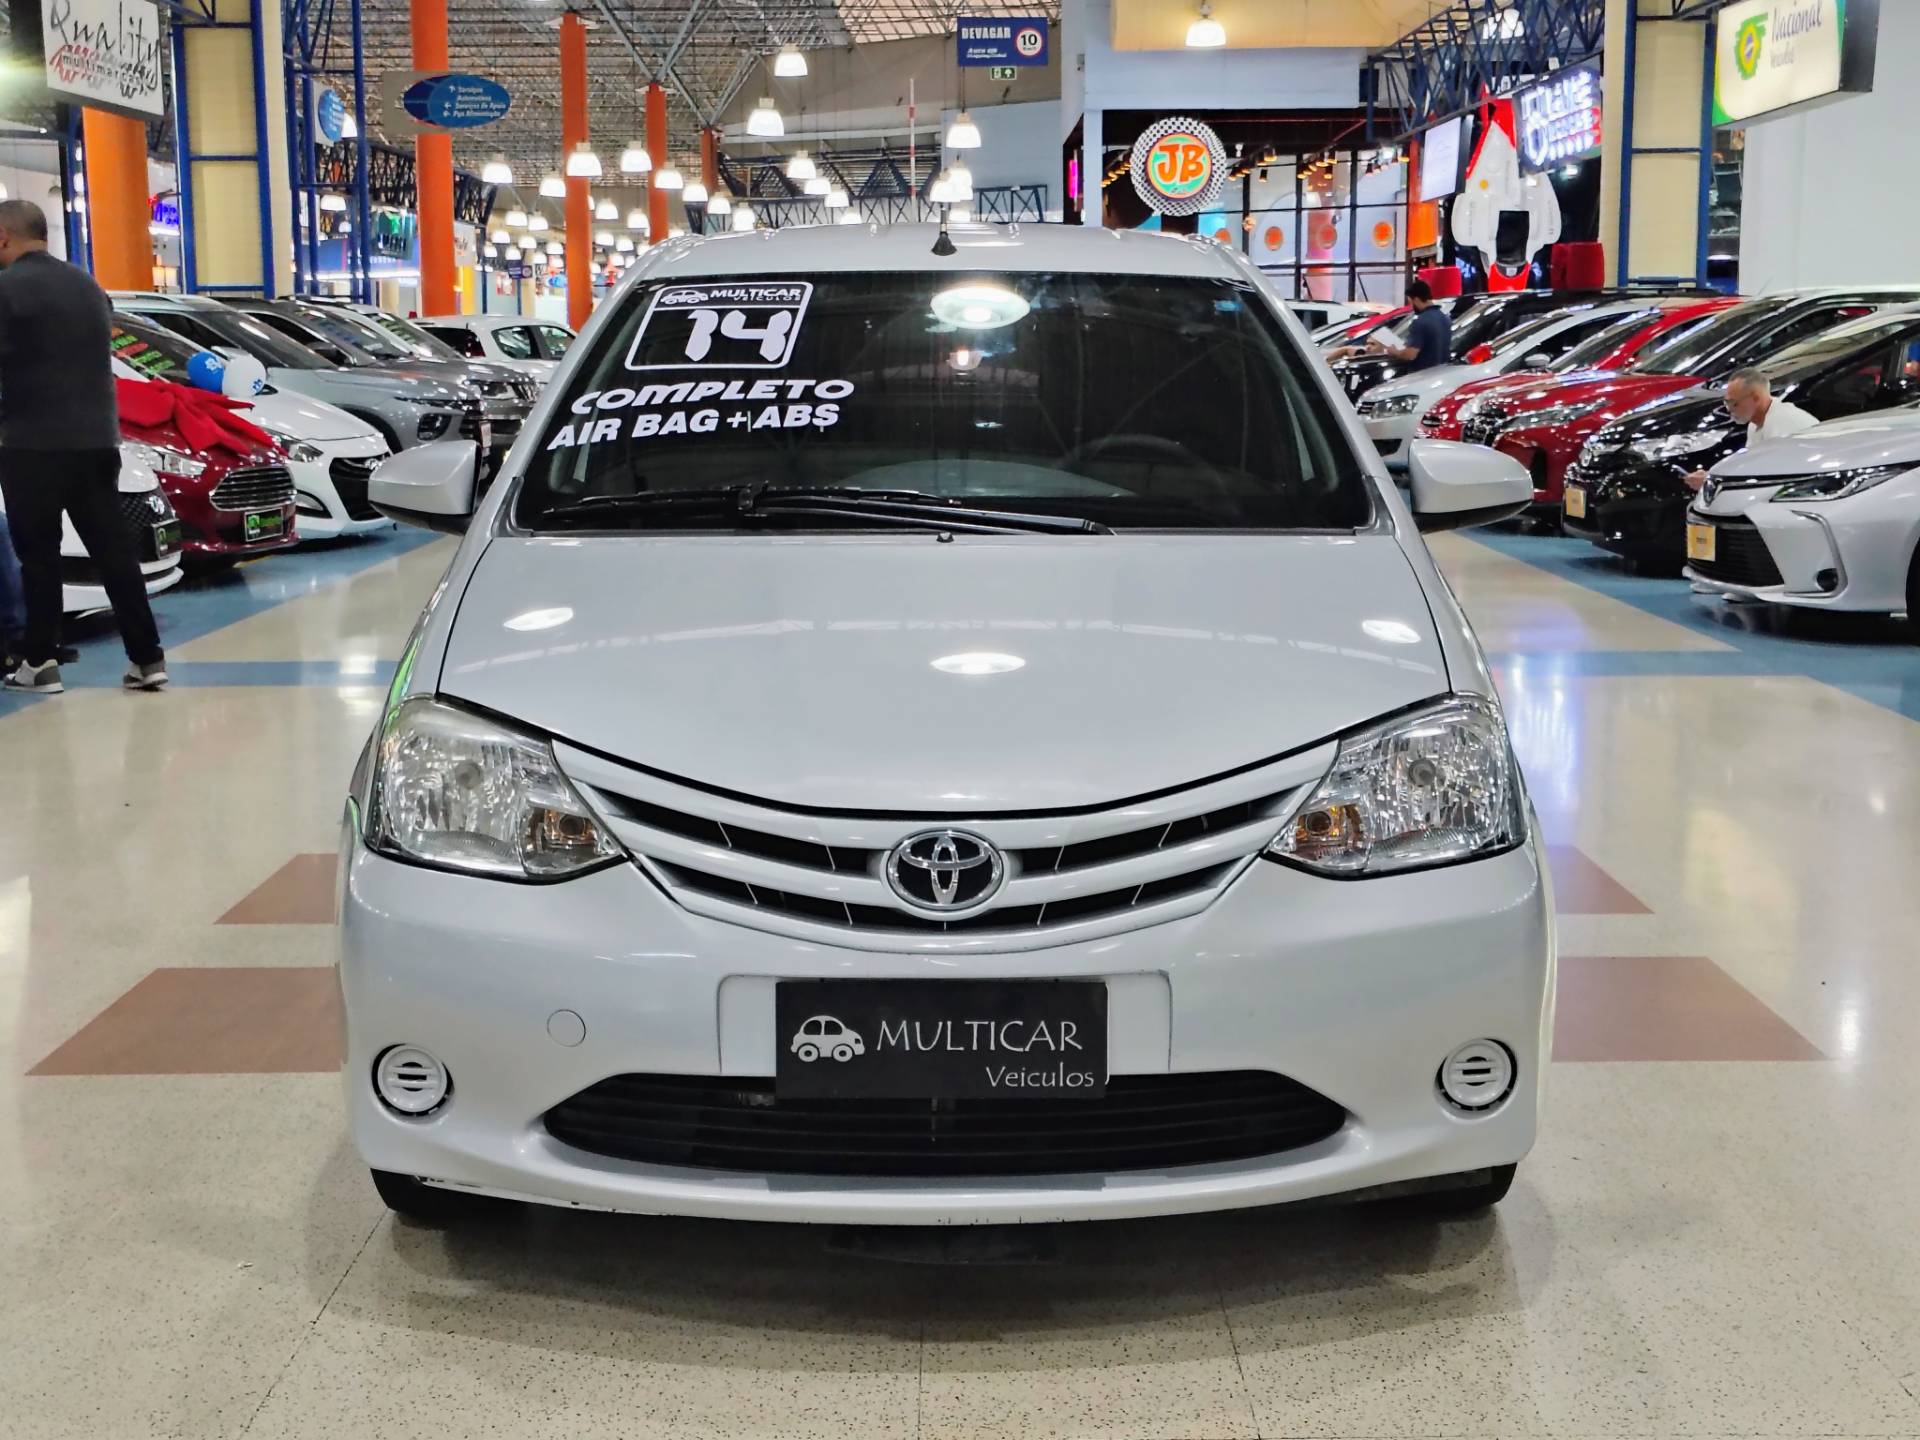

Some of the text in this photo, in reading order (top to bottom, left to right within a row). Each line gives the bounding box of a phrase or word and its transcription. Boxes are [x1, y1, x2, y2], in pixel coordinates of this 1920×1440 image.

[961, 27, 1011, 39] DEVAGAR
[1770, 0, 1823, 43] Nacional
[49, 0, 160, 91] Quality
[1021, 34, 1038, 46] 10
[1157, 143, 1206, 184] JB
[709, 288, 802, 298] MULTICAR
[685, 309, 792, 362] 14
[571, 379, 855, 414] COMPLETO
[546, 418, 622, 450] AIR
[631, 409, 720, 438] BAG
[876, 1020, 1083, 1052] MULTICAR
[986, 1061, 1095, 1088] Veiculos
